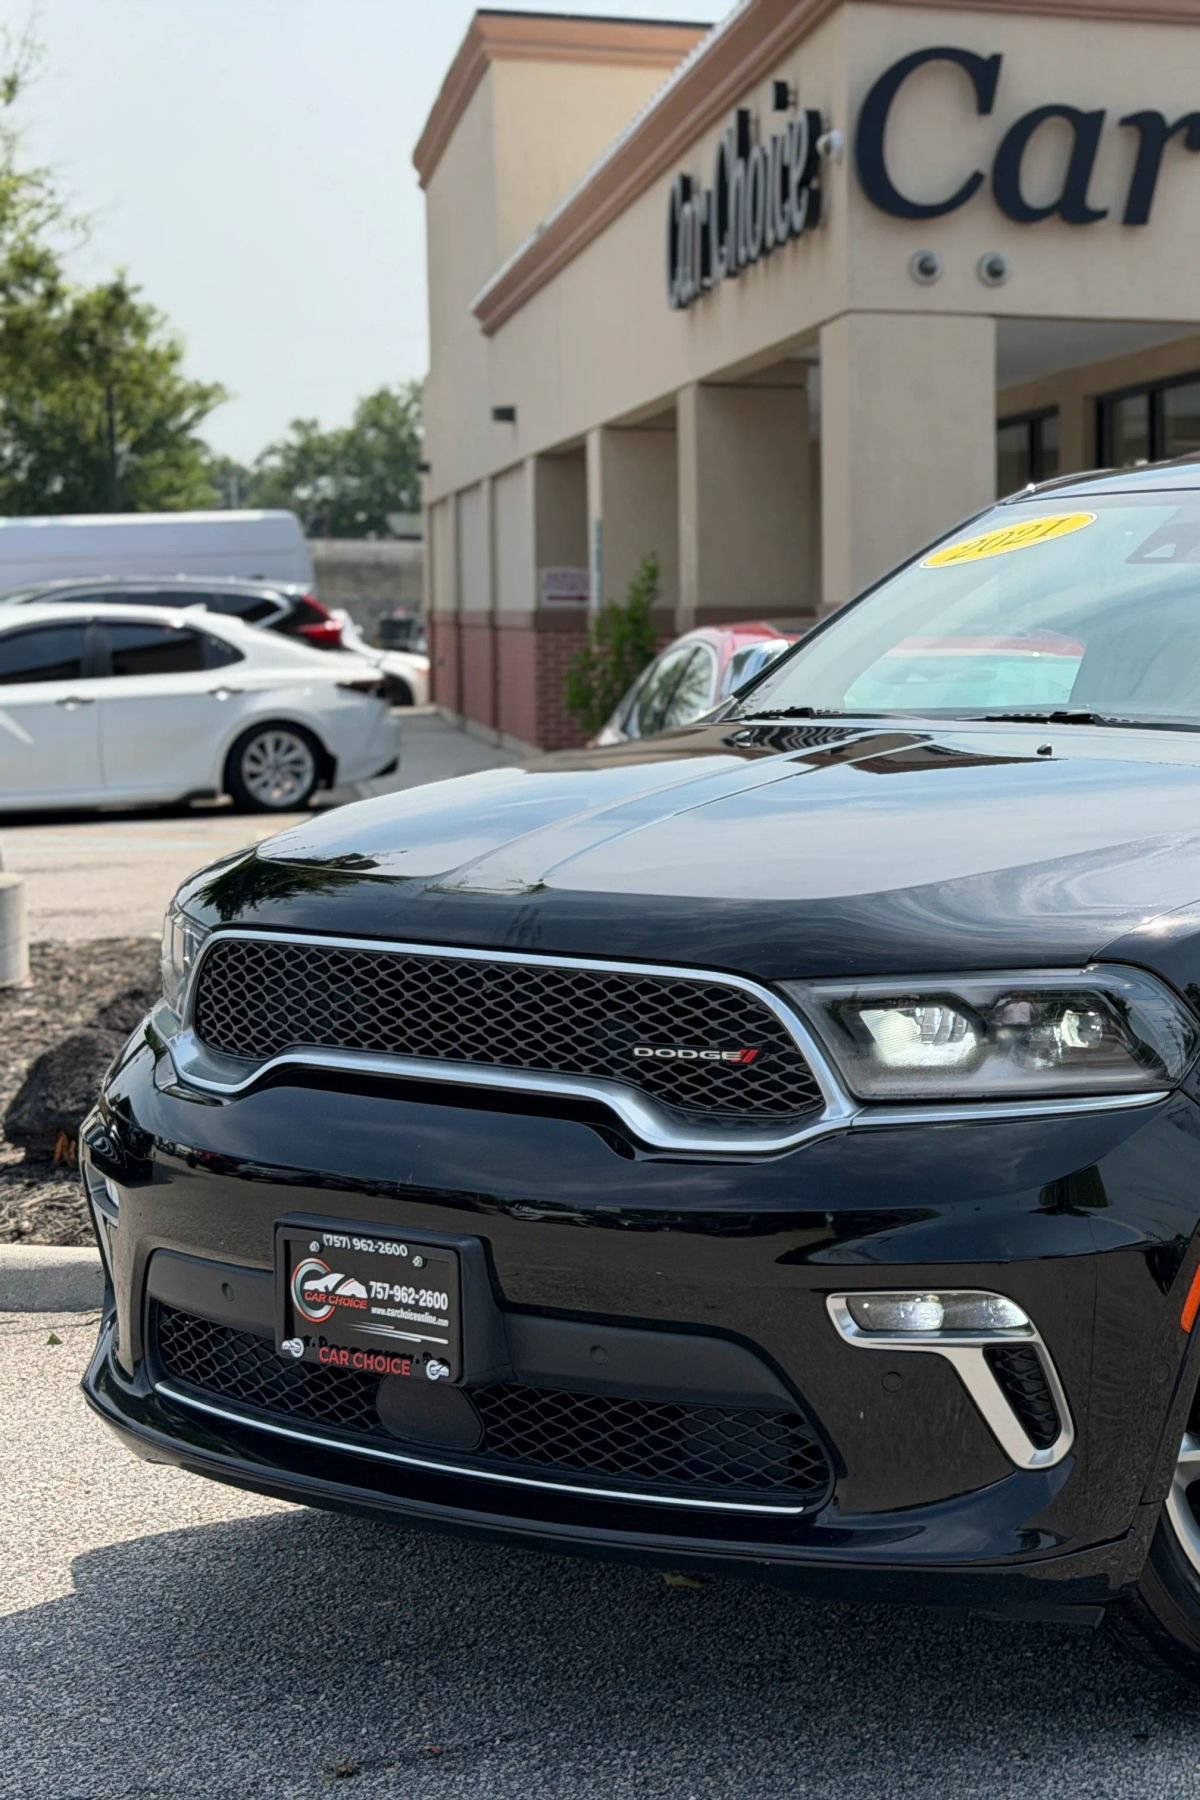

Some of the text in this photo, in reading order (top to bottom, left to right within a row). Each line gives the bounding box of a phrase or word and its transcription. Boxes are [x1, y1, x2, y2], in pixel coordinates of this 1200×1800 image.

[667, 80, 823, 309] Car Choice
[944, 516, 1073, 562] 2021
[633, 1047, 743, 1062] DODGE
[323, 1233, 409, 1257] (757) 962-2600
[304, 1291, 369, 1310] CAR CHOICE
[369, 1281, 449, 1311] 757-962-2600
[371, 1306, 450, 1328] www.carchoiceonline.com
[319, 1346, 412, 1377] CAR CHOICE
